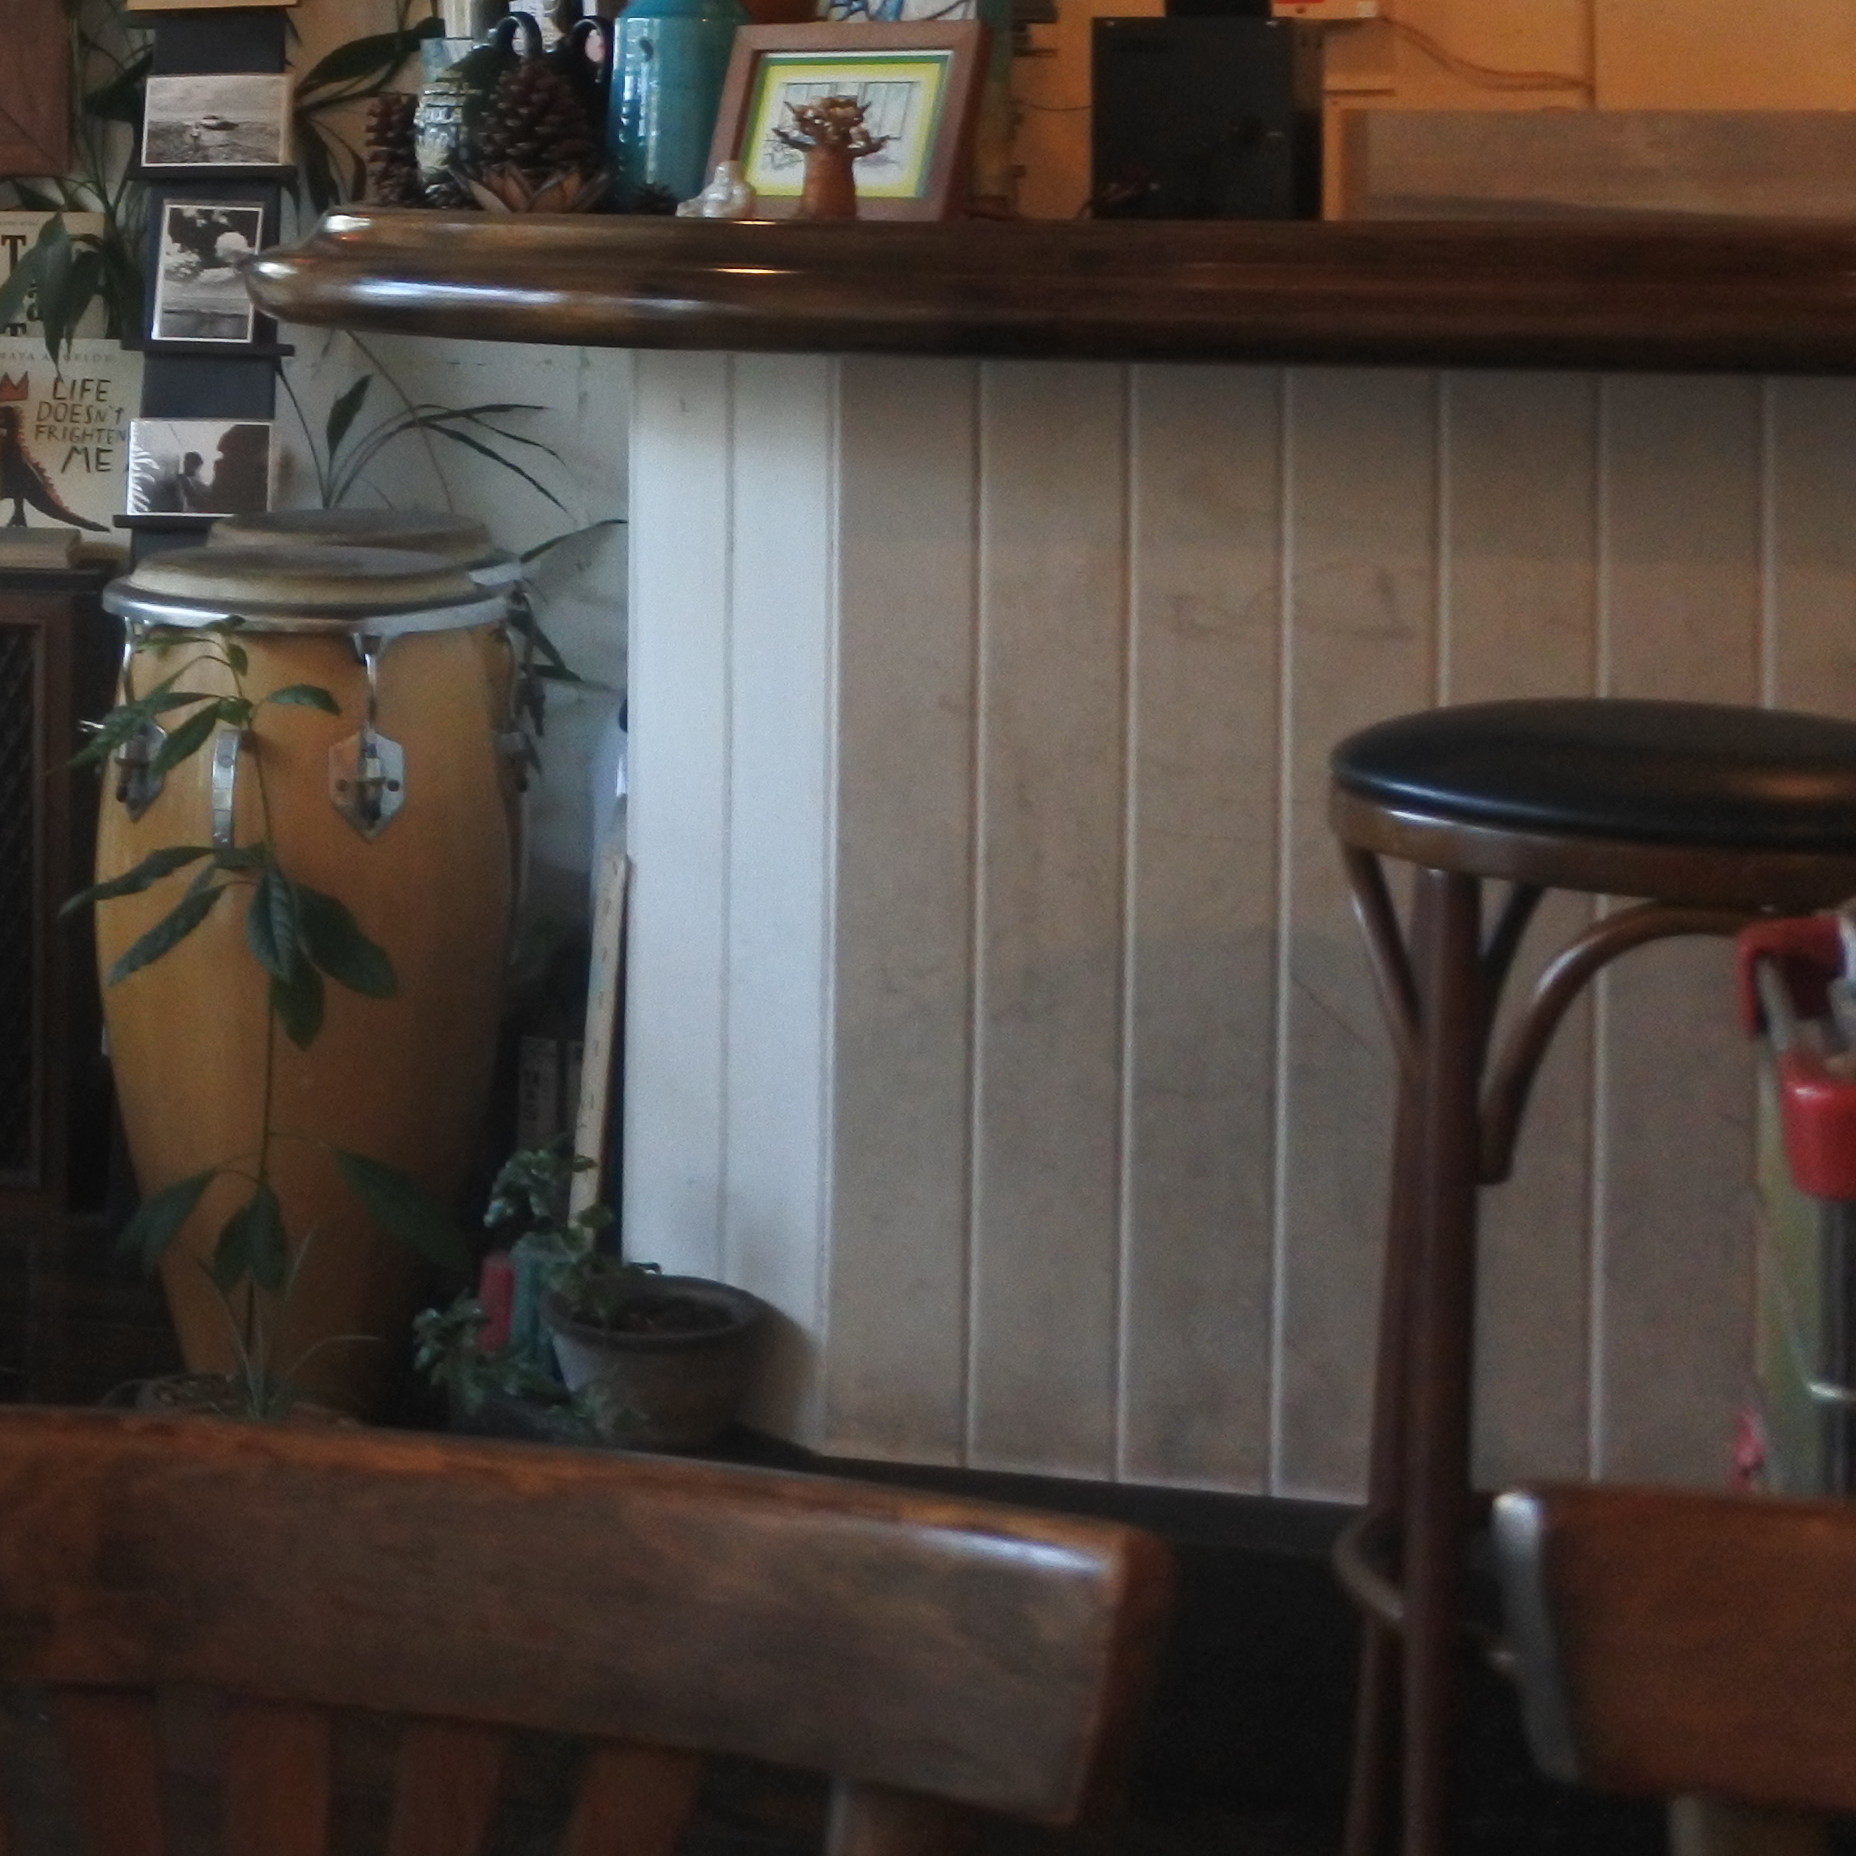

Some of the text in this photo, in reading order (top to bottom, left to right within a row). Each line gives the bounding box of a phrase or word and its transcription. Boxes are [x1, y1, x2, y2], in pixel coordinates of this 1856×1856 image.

[52, 378, 112, 402] LIFE
[34, 423, 127, 444] FRIGHTEN
[60, 445, 113, 475] ME
